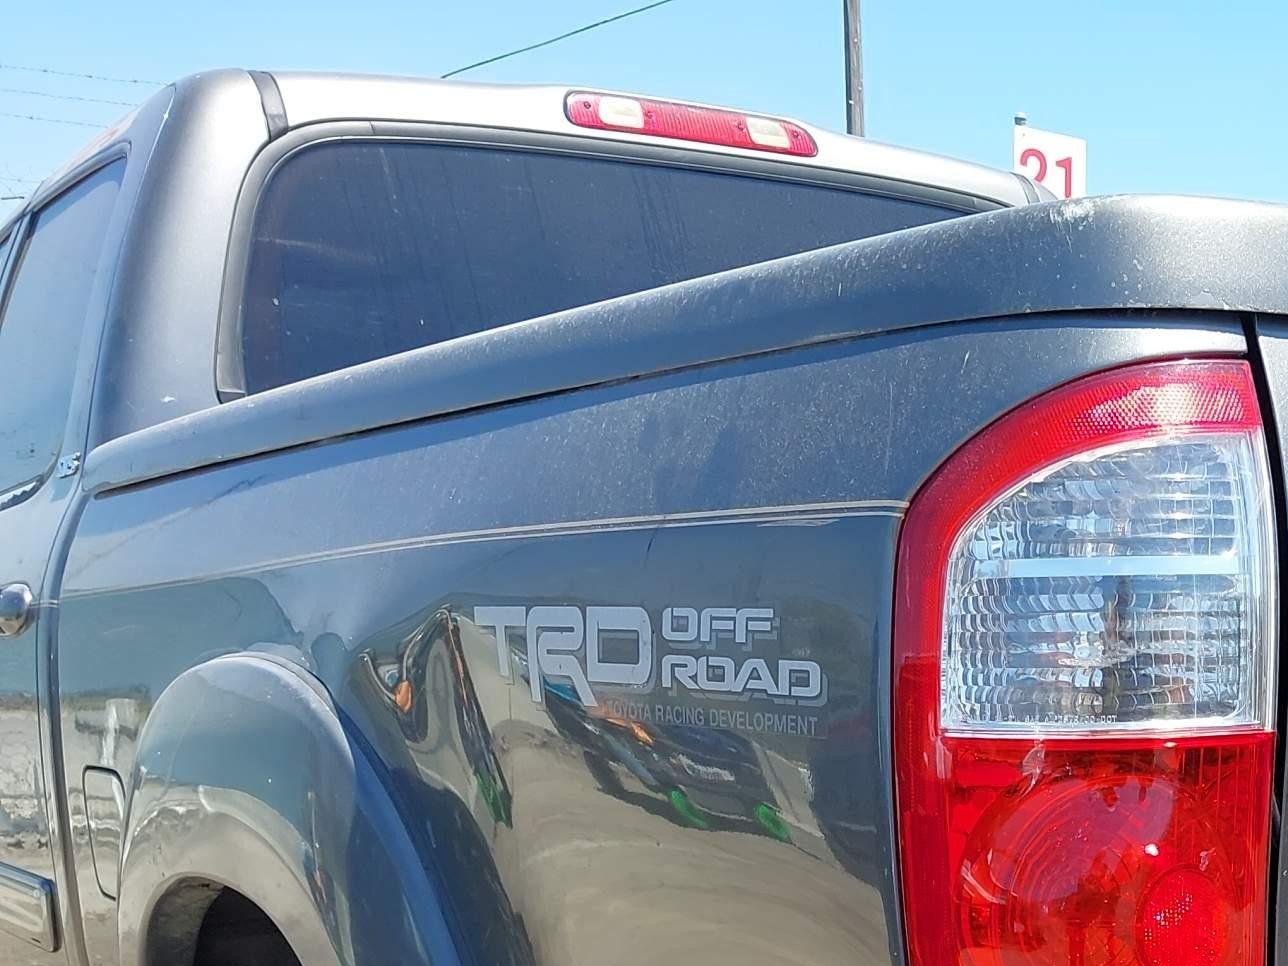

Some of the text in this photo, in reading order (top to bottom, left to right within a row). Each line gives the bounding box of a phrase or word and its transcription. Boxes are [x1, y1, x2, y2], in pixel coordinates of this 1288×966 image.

[1020, 148, 1072, 199] 21
[662, 607, 774, 643] OFF
[474, 605, 653, 706] TRD
[661, 655, 821, 698] ROAD
[607, 701, 818, 737] TOYOTA RACING DEVELOPMENT
